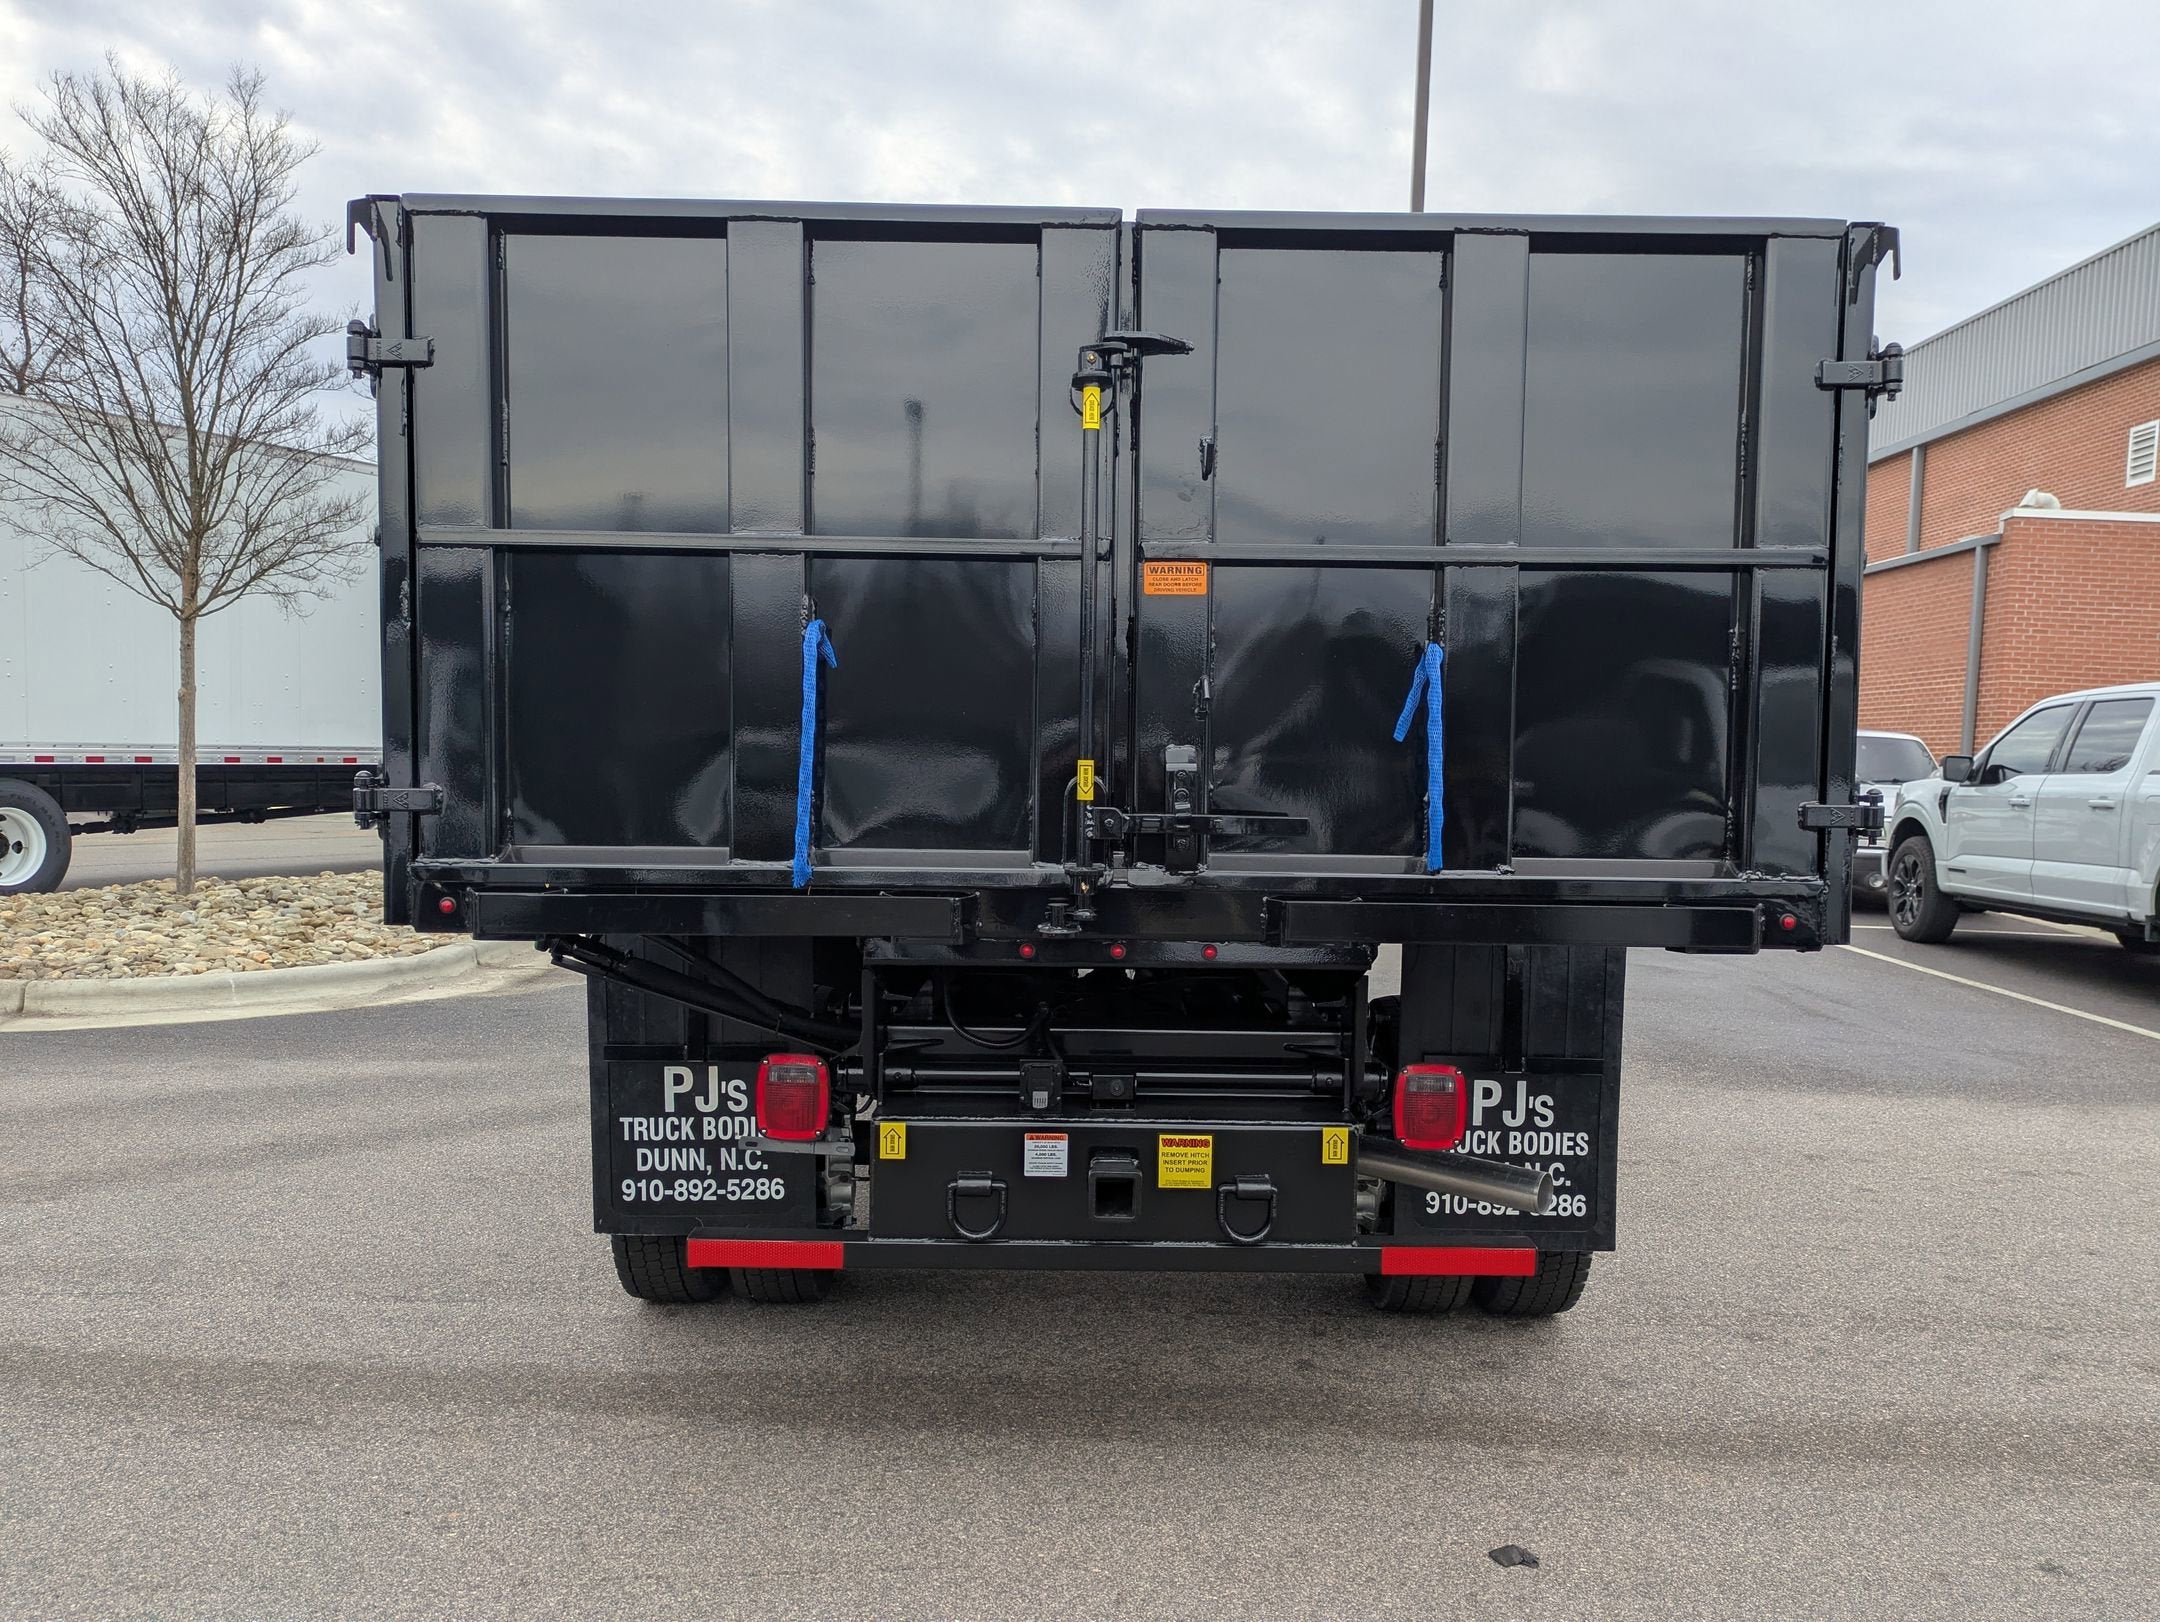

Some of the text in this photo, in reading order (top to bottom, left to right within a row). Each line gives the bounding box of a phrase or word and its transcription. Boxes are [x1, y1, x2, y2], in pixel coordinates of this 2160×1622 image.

[1149, 566, 1202, 575] WARNING
[619, 1117, 764, 1141] TRUCK BODI
[1161, 1138, 1210, 1148] WARNING
[1450, 1131, 1589, 1156] UCK BODIES
[636, 1147, 769, 1176] DUNN, N.C.
[621, 1178, 785, 1202] 910-892-5286
